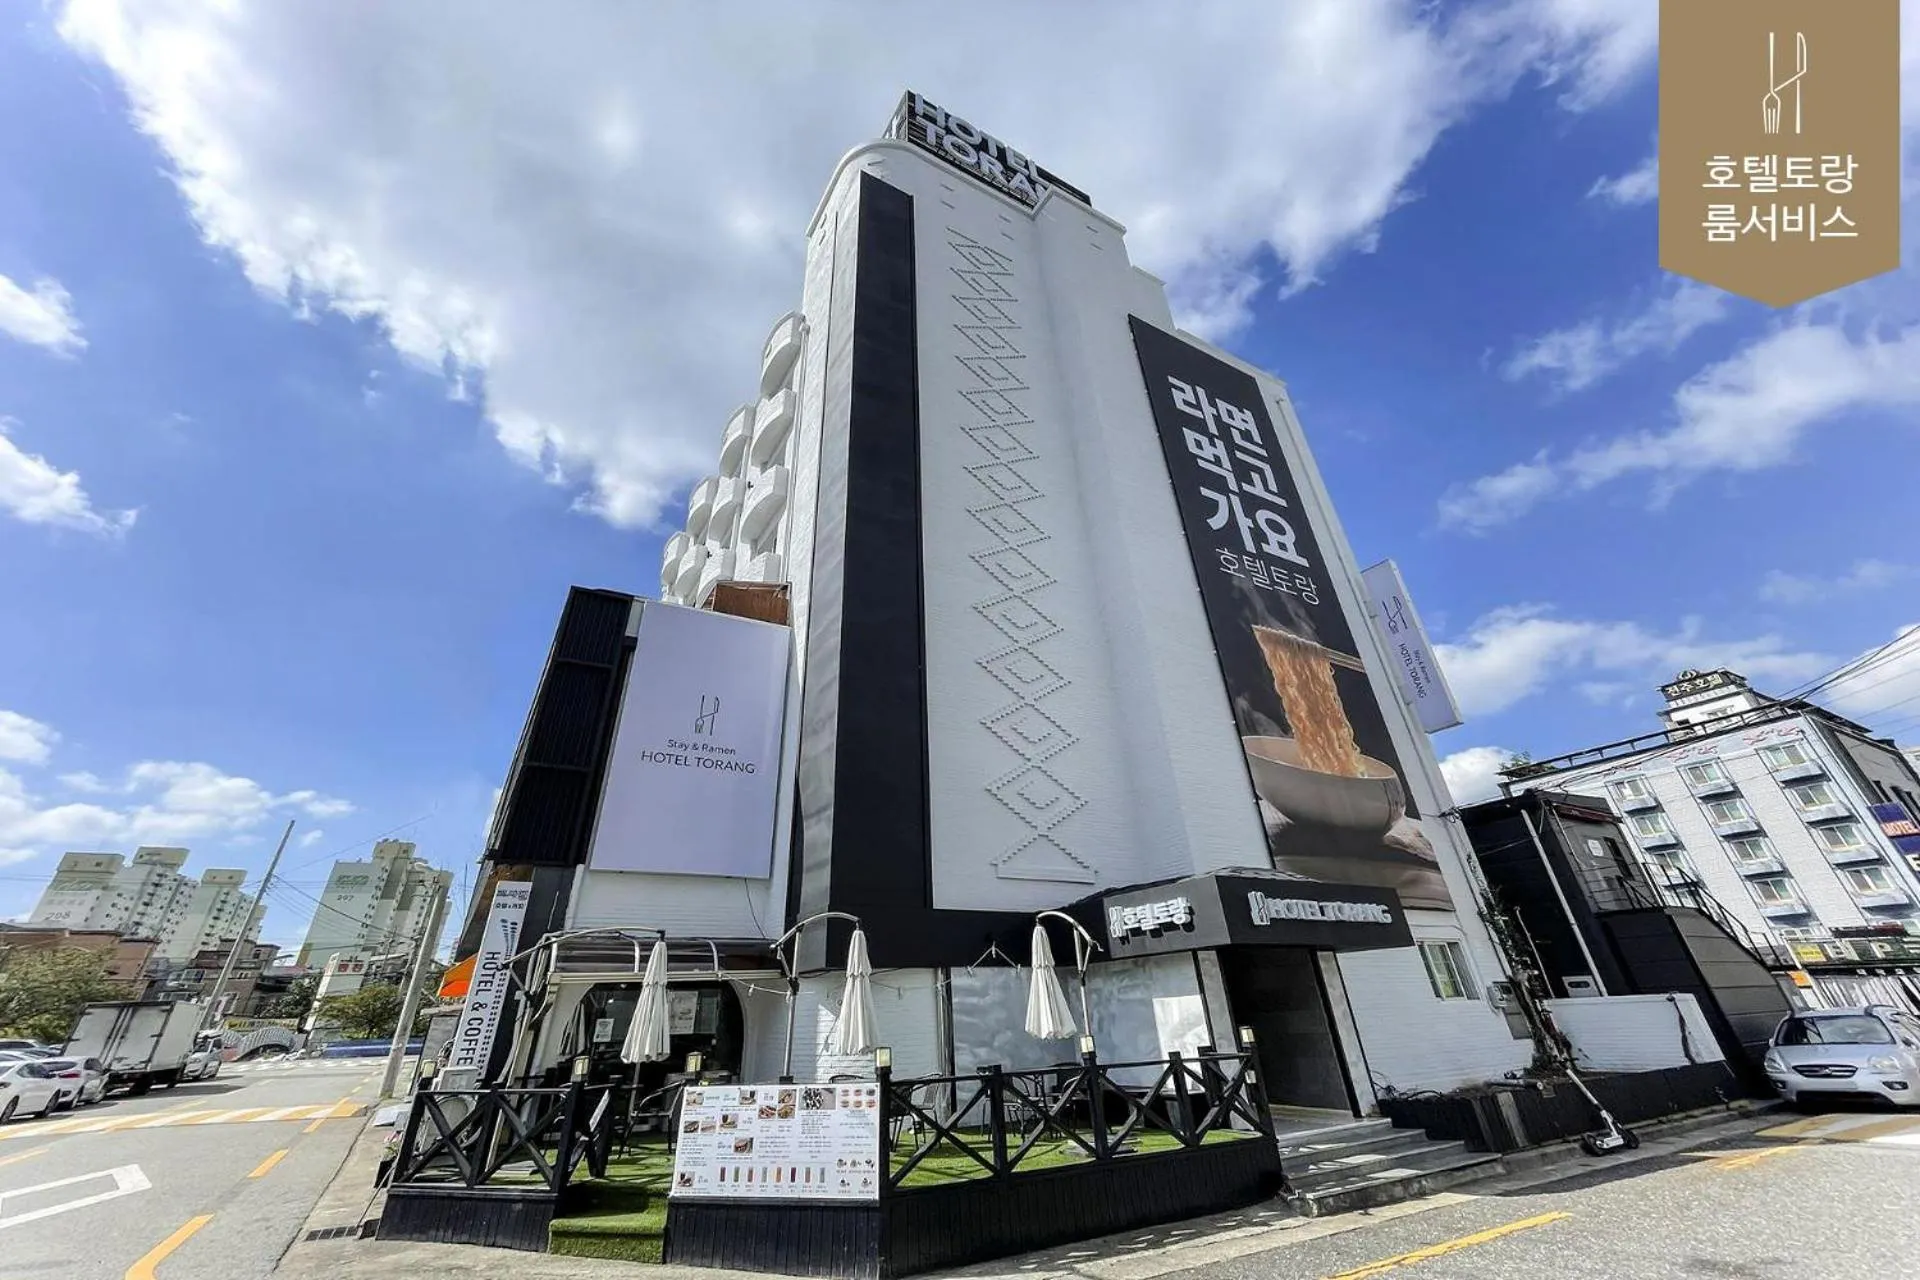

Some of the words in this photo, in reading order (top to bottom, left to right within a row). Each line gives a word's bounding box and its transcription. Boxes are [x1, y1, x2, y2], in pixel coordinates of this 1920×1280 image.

[914, 92, 1051, 188] HOTEL
[915, 115, 1047, 207] TORA
[1167, 375, 1268, 457] 라면
[1182, 426, 1288, 508] 먹고
[1199, 486, 1310, 568] 가요
[1215, 547, 1319, 605] 호텔토랑
[641, 750, 690, 767] HOTEL
[695, 757, 755, 774] TORANG
[667, 739, 690, 752] Stay
[692, 742, 699, 751] &
[702, 744, 736, 756] Ramen
[1122, 897, 1190, 931] 호텔토랑
[475, 951, 501, 996] HOTEL
[471, 1001, 488, 1013] &
[456, 1017, 484, 1067] COFFE
